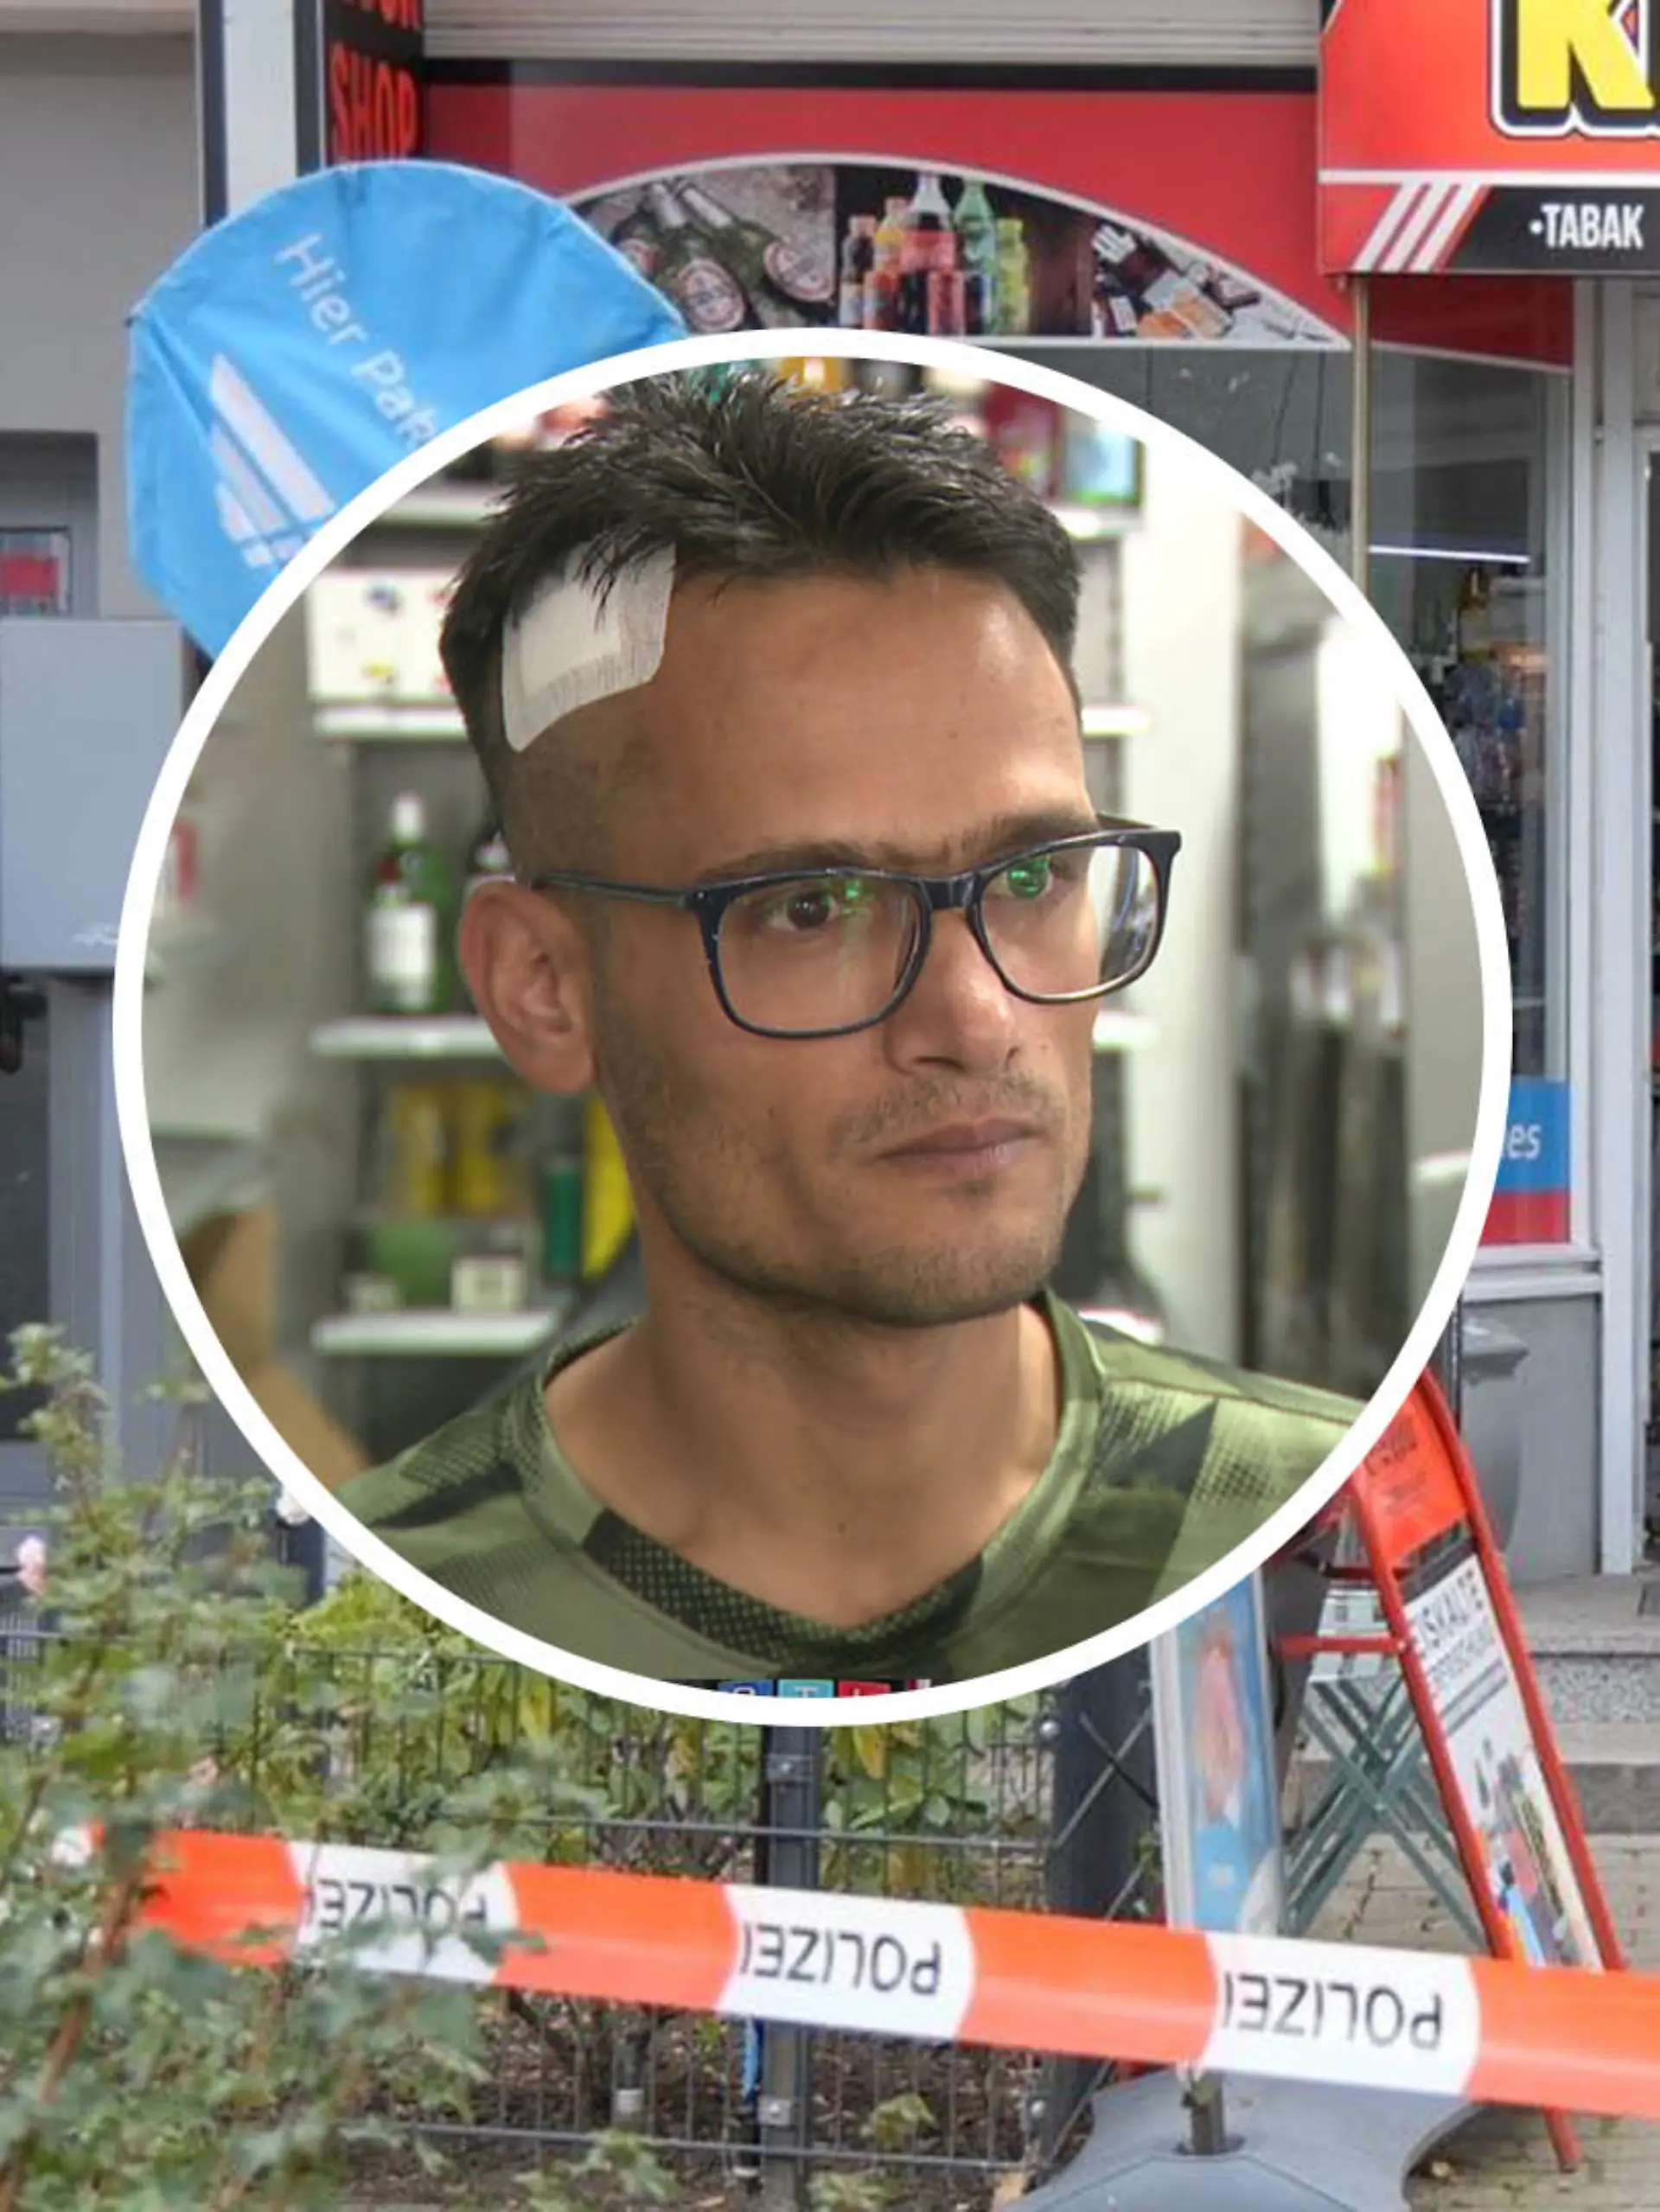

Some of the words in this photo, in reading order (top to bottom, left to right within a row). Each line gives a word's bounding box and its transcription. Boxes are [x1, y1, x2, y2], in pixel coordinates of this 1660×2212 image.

[329, 43, 417, 162] SHOP
[274, 233, 368, 344] Hier
[1504, 1124, 1542, 1158] es
[740, 1922, 941, 1996] POLIZEI
[1222, 1972, 1442, 2050] POLIZEI
